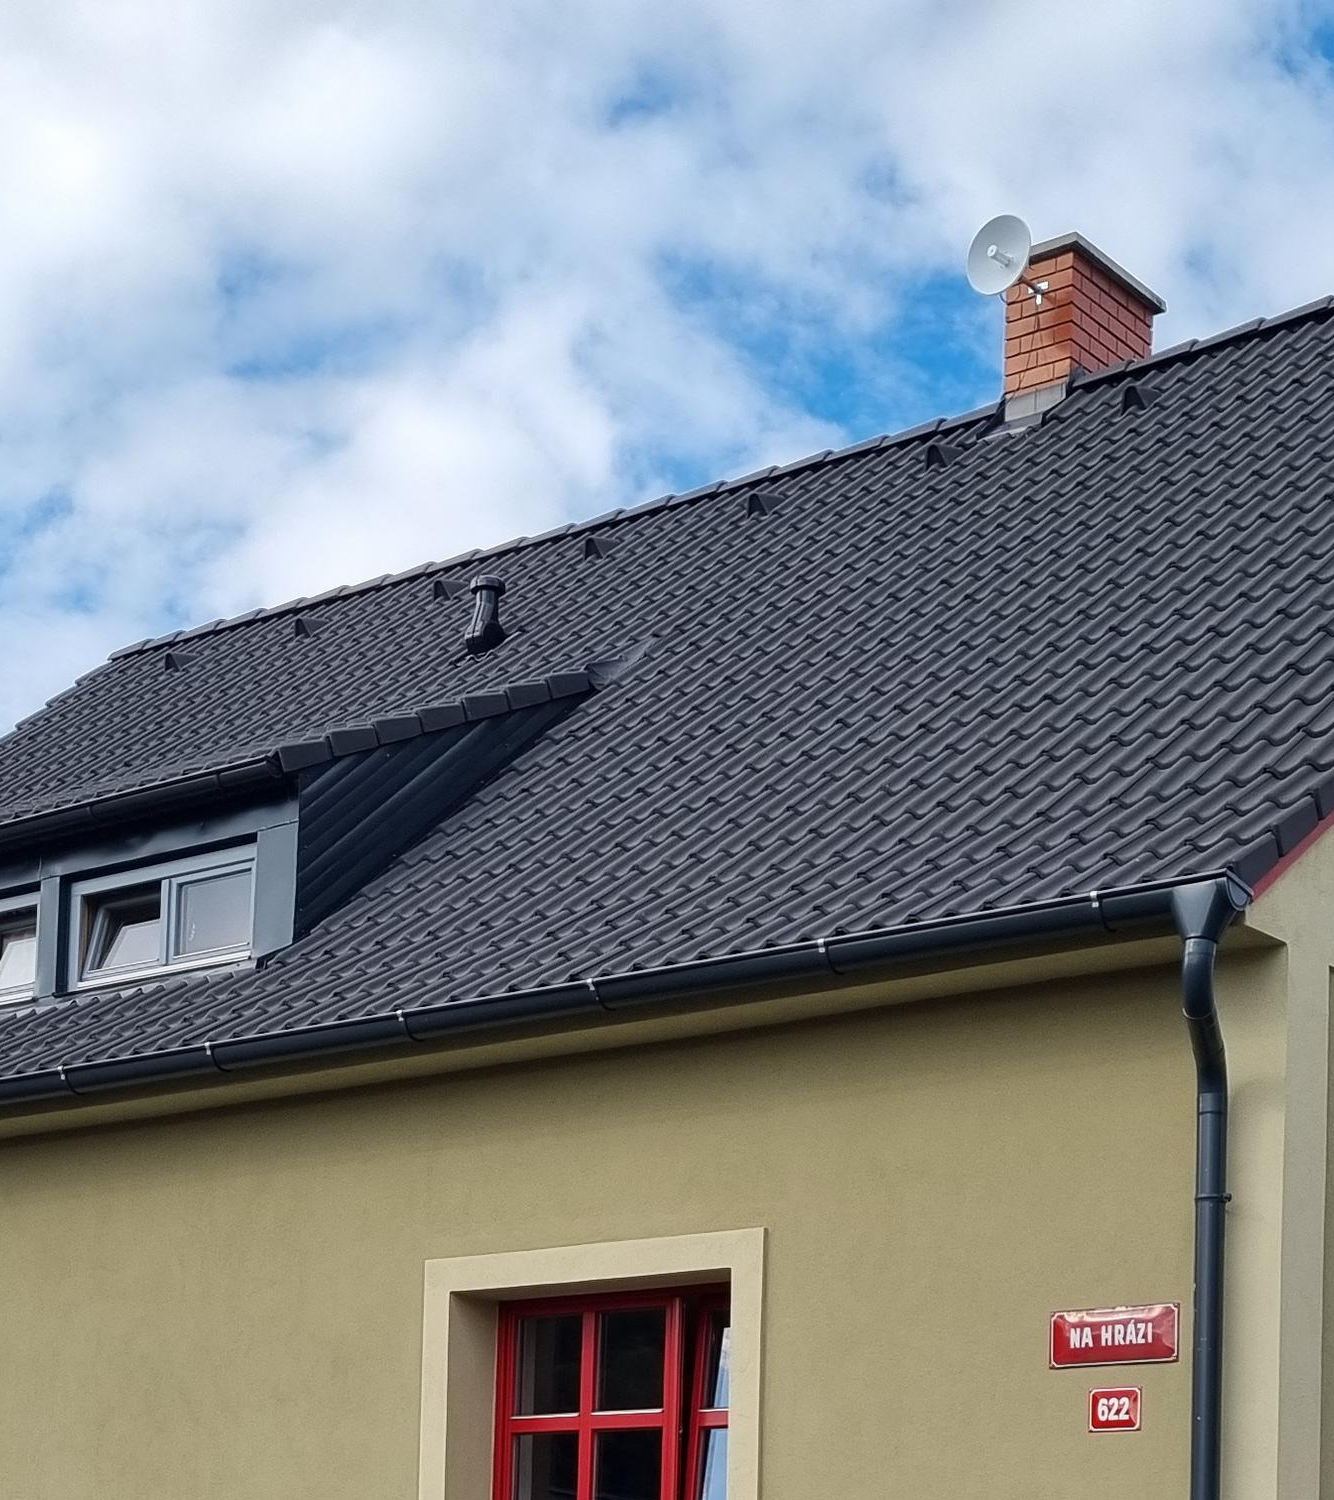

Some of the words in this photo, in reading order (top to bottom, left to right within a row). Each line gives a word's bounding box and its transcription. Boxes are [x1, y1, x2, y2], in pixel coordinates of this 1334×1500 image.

[1069, 1327, 1094, 1349] NA
[1100, 1320, 1153, 1347] HRÁZI
[1097, 1397, 1130, 1422] 622
